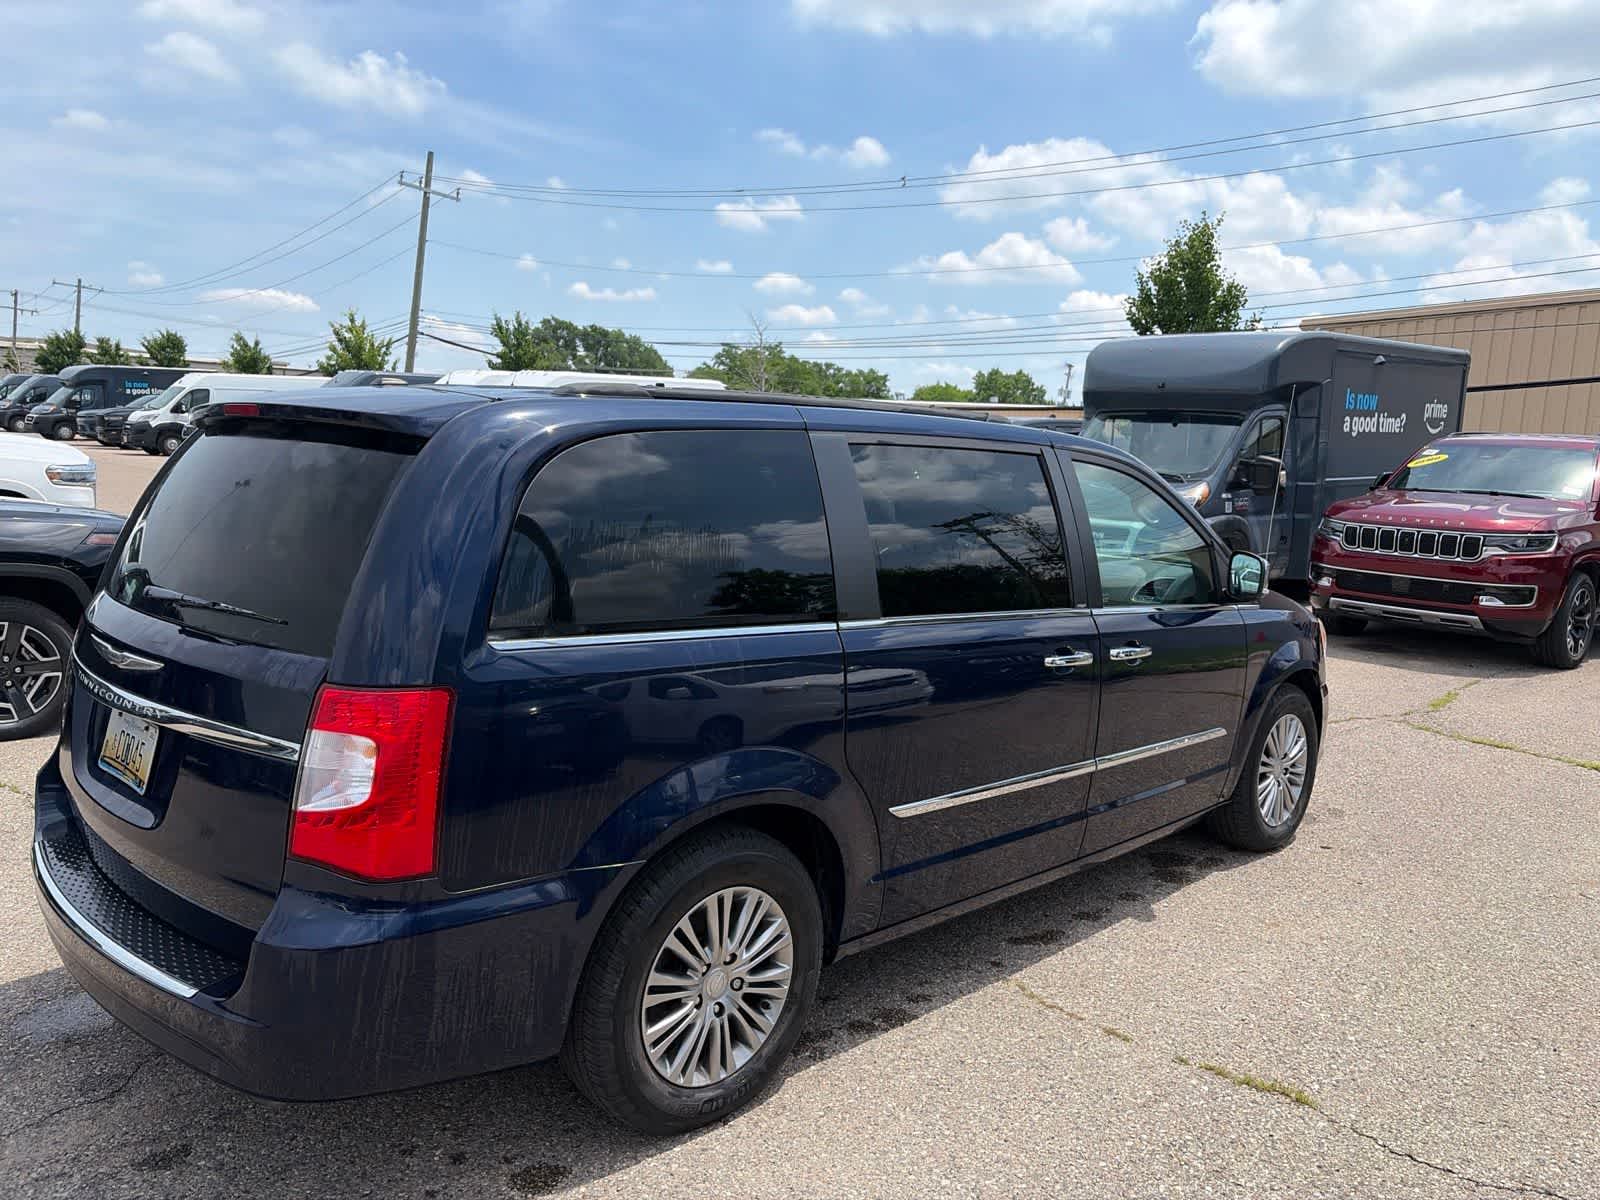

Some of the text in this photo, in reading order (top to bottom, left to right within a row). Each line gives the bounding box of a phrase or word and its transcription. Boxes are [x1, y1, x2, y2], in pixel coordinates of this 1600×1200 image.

[132, 387, 150, 395] good
[1345, 388, 1378, 410] Is now
[1424, 399, 1448, 421] prime
[1343, 411, 1406, 437] a good time?
